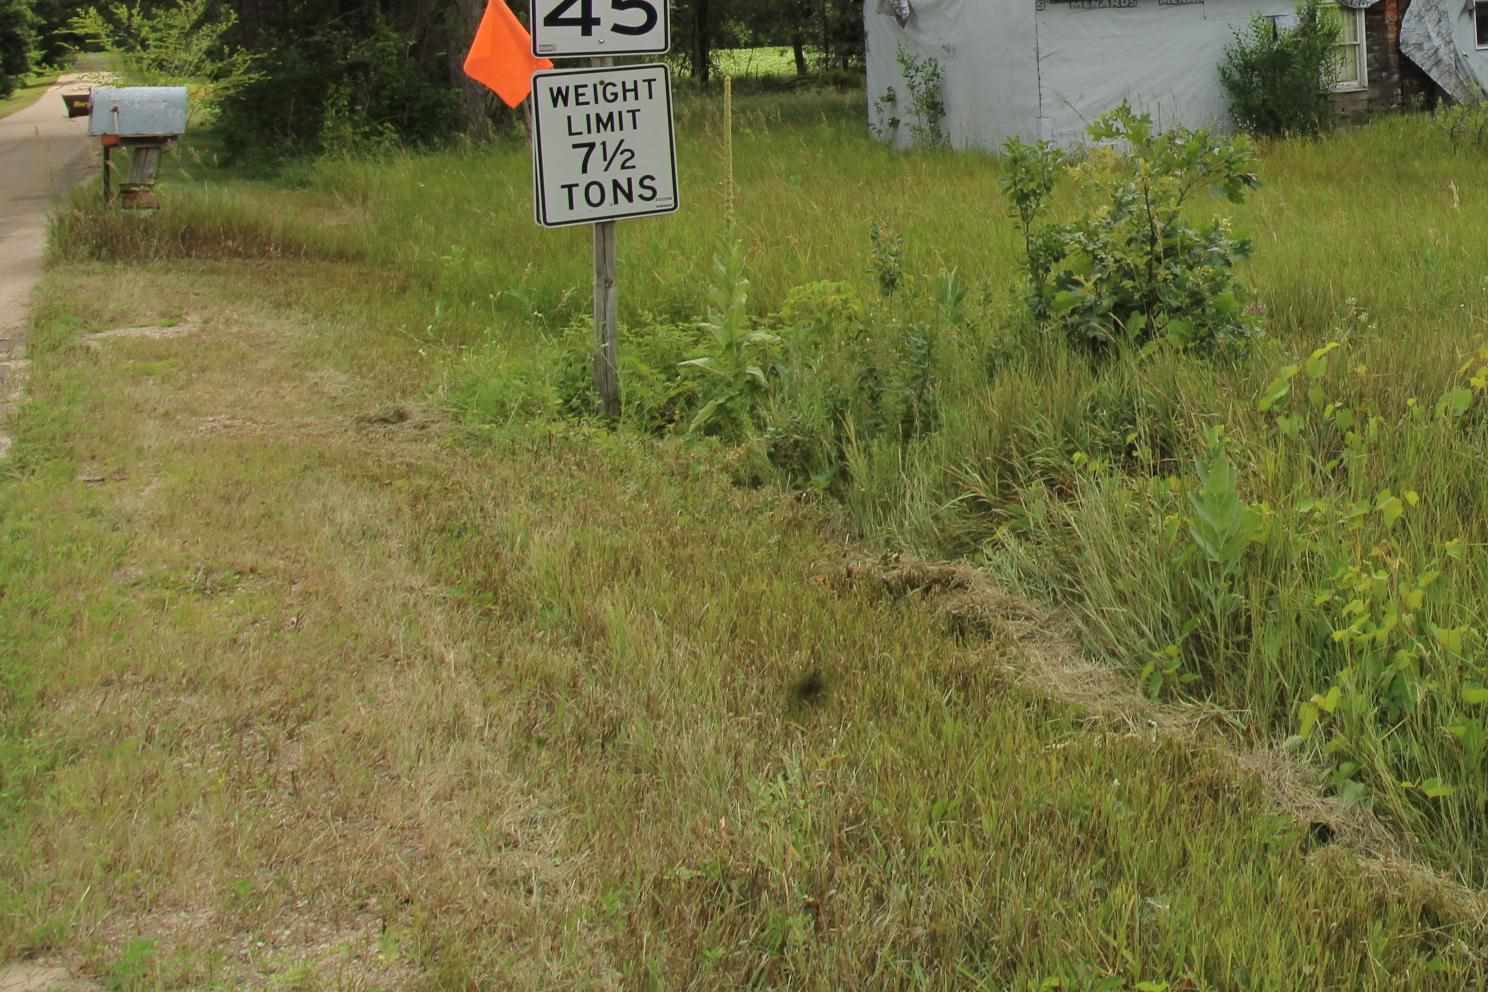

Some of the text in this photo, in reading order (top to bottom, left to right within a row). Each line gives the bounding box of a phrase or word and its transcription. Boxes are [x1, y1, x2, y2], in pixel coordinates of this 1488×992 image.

[549, 78, 657, 108] WEIGHT
[567, 109, 641, 137] LIMIT
[560, 174, 658, 211] TONS
